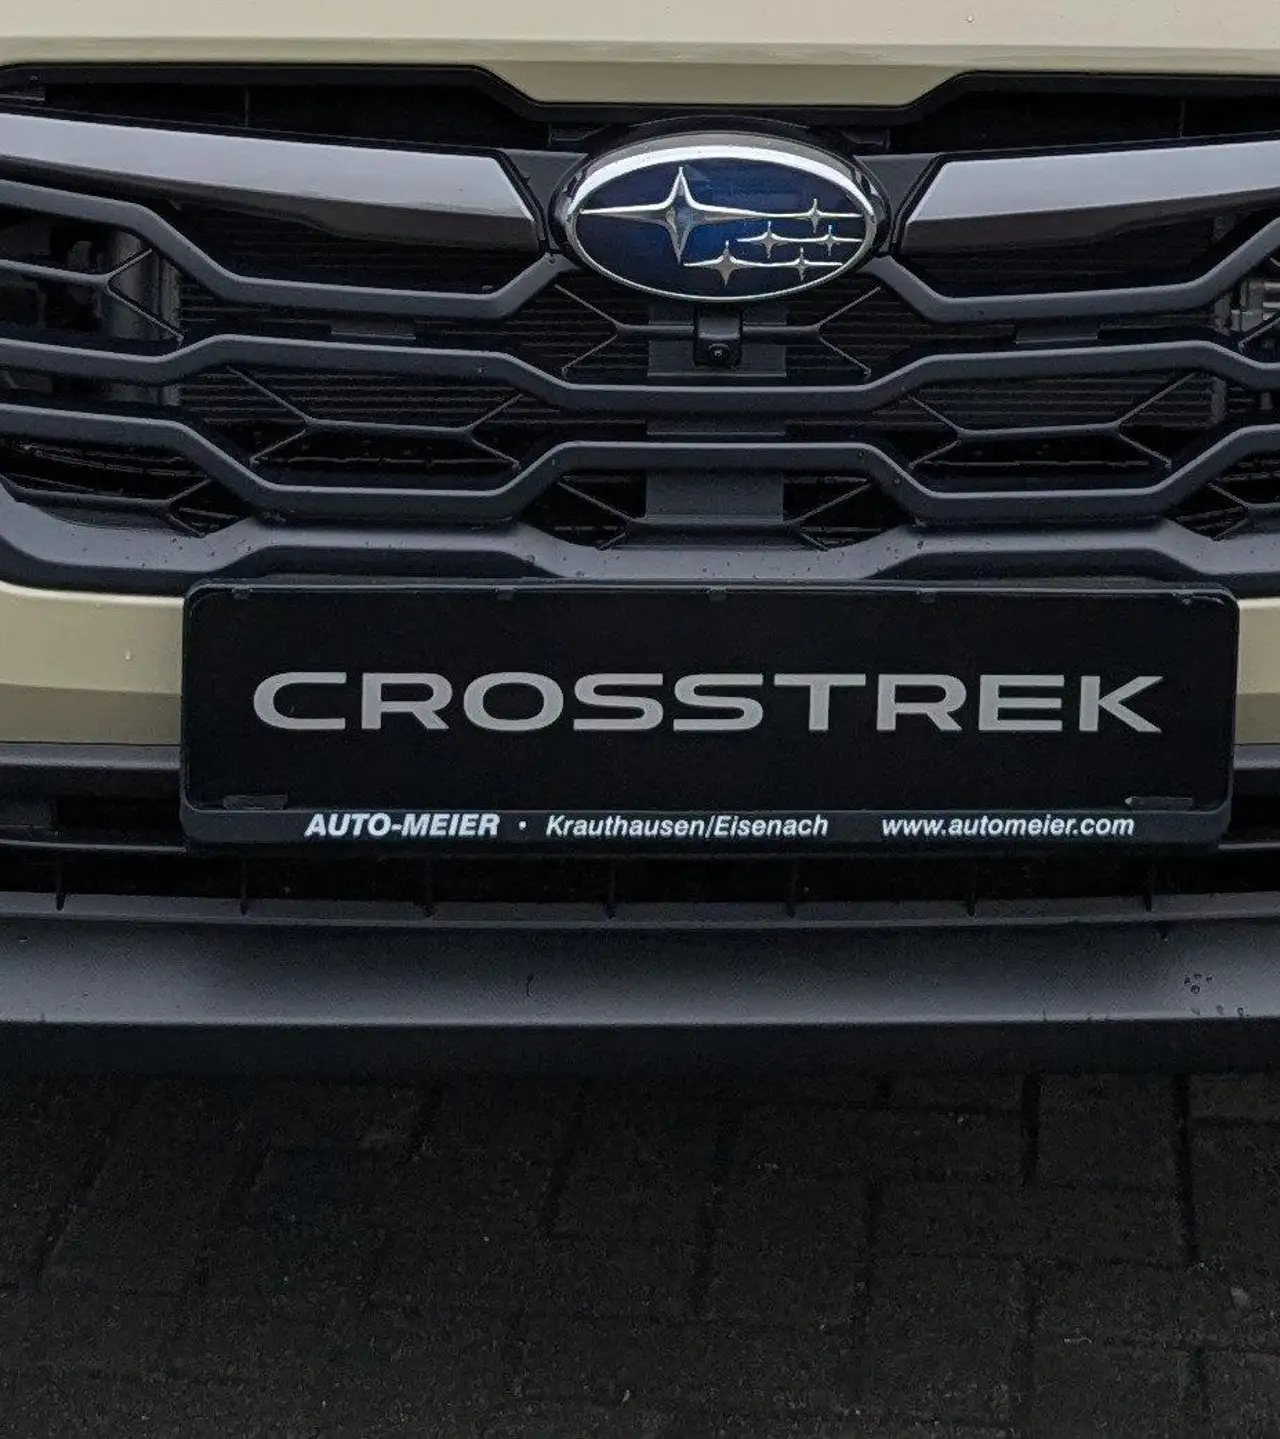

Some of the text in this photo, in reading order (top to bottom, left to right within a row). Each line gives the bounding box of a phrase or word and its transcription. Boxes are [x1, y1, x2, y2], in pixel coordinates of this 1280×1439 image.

[253, 671, 1163, 733] CROSSTREK
[304, 812, 1135, 839] AUTO-MEIER Krauthausen/Eisenach www.automeier.com
